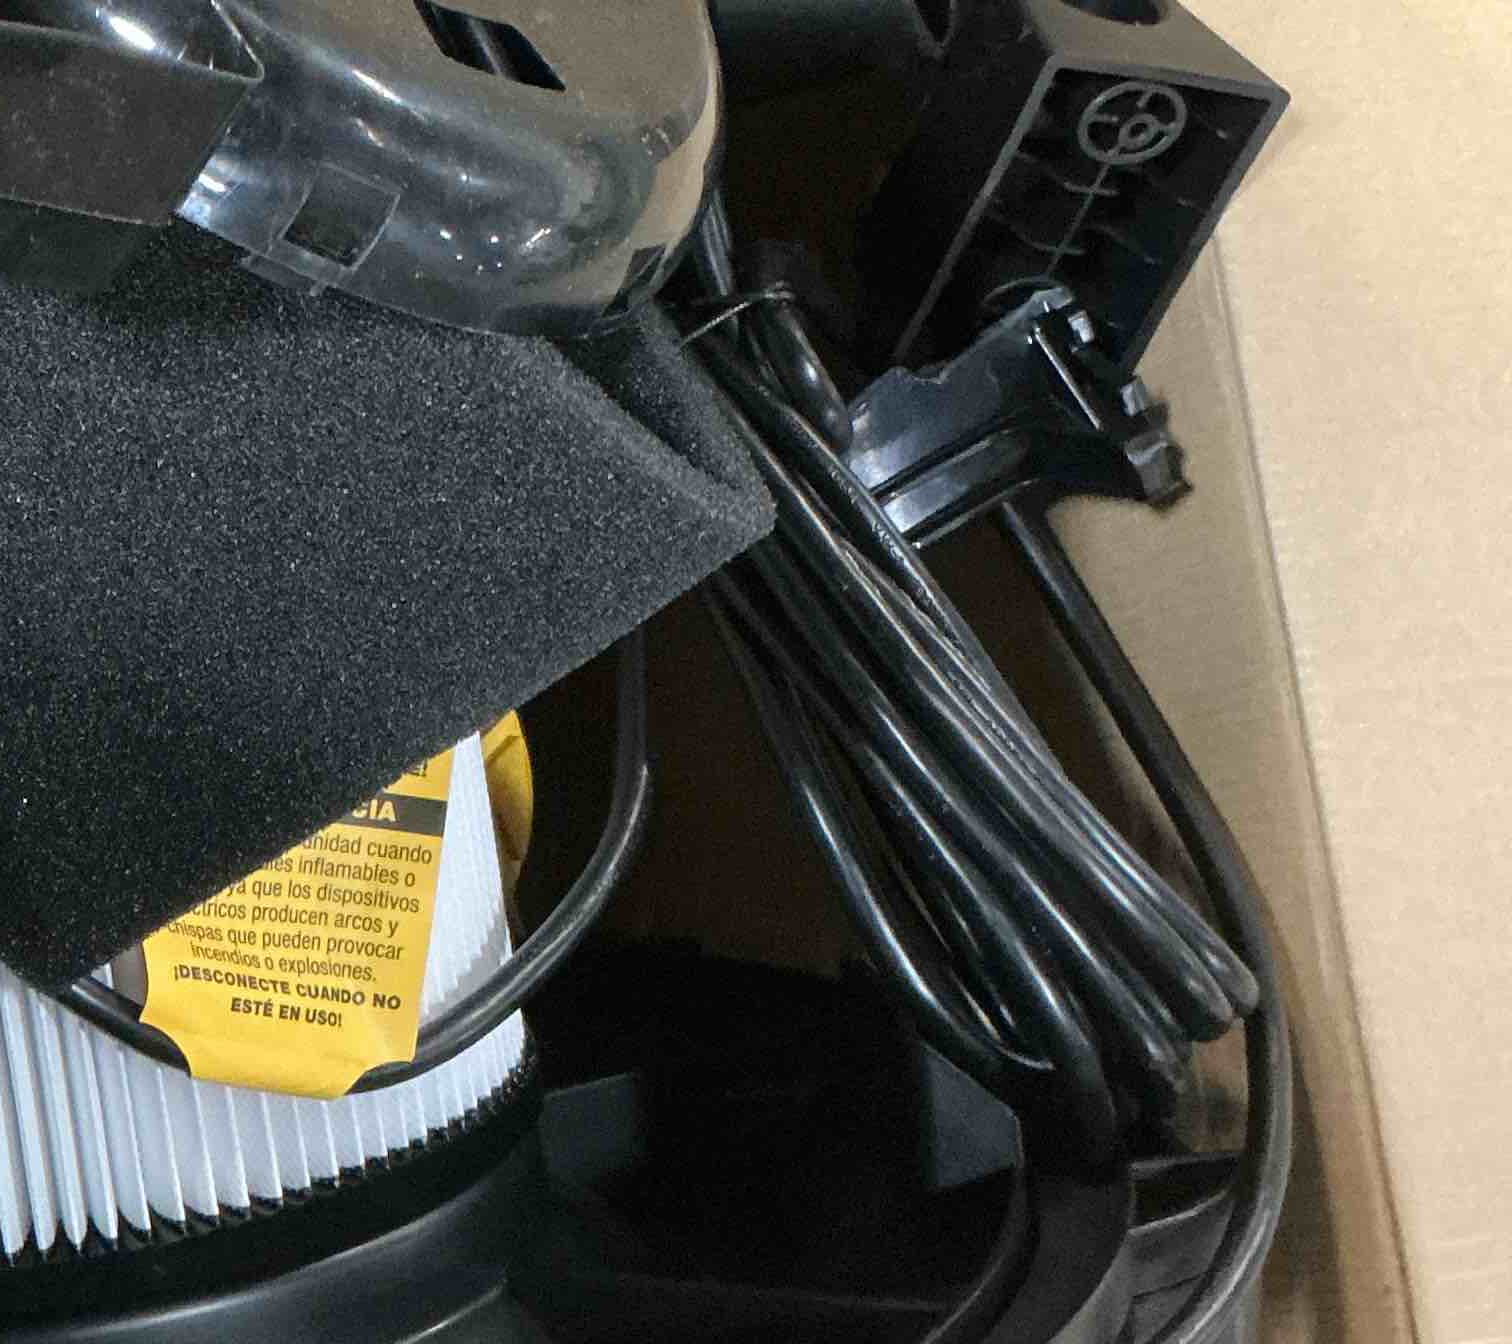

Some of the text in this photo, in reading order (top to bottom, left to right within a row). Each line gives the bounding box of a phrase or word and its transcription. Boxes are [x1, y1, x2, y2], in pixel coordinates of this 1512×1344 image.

[367, 837, 432, 863] cuando
[298, 856, 399, 885] inflamables
[405, 873, 415, 886] o
[252, 880, 282, 901] que
[288, 880, 311, 899] los
[317, 884, 419, 913] dispositivos
[252, 904, 399, 938] producen arcos y
[228, 929, 257, 950] que
[262, 930, 321, 952] pueden
[327, 938, 403, 961] provocar
[190, 942, 377, 982] incendios o explosiones.
[174, 965, 401, 1010] ¡DESCONECTE CUANDO NO
[231, 997, 342, 1027] ESTÉ EN USO!
